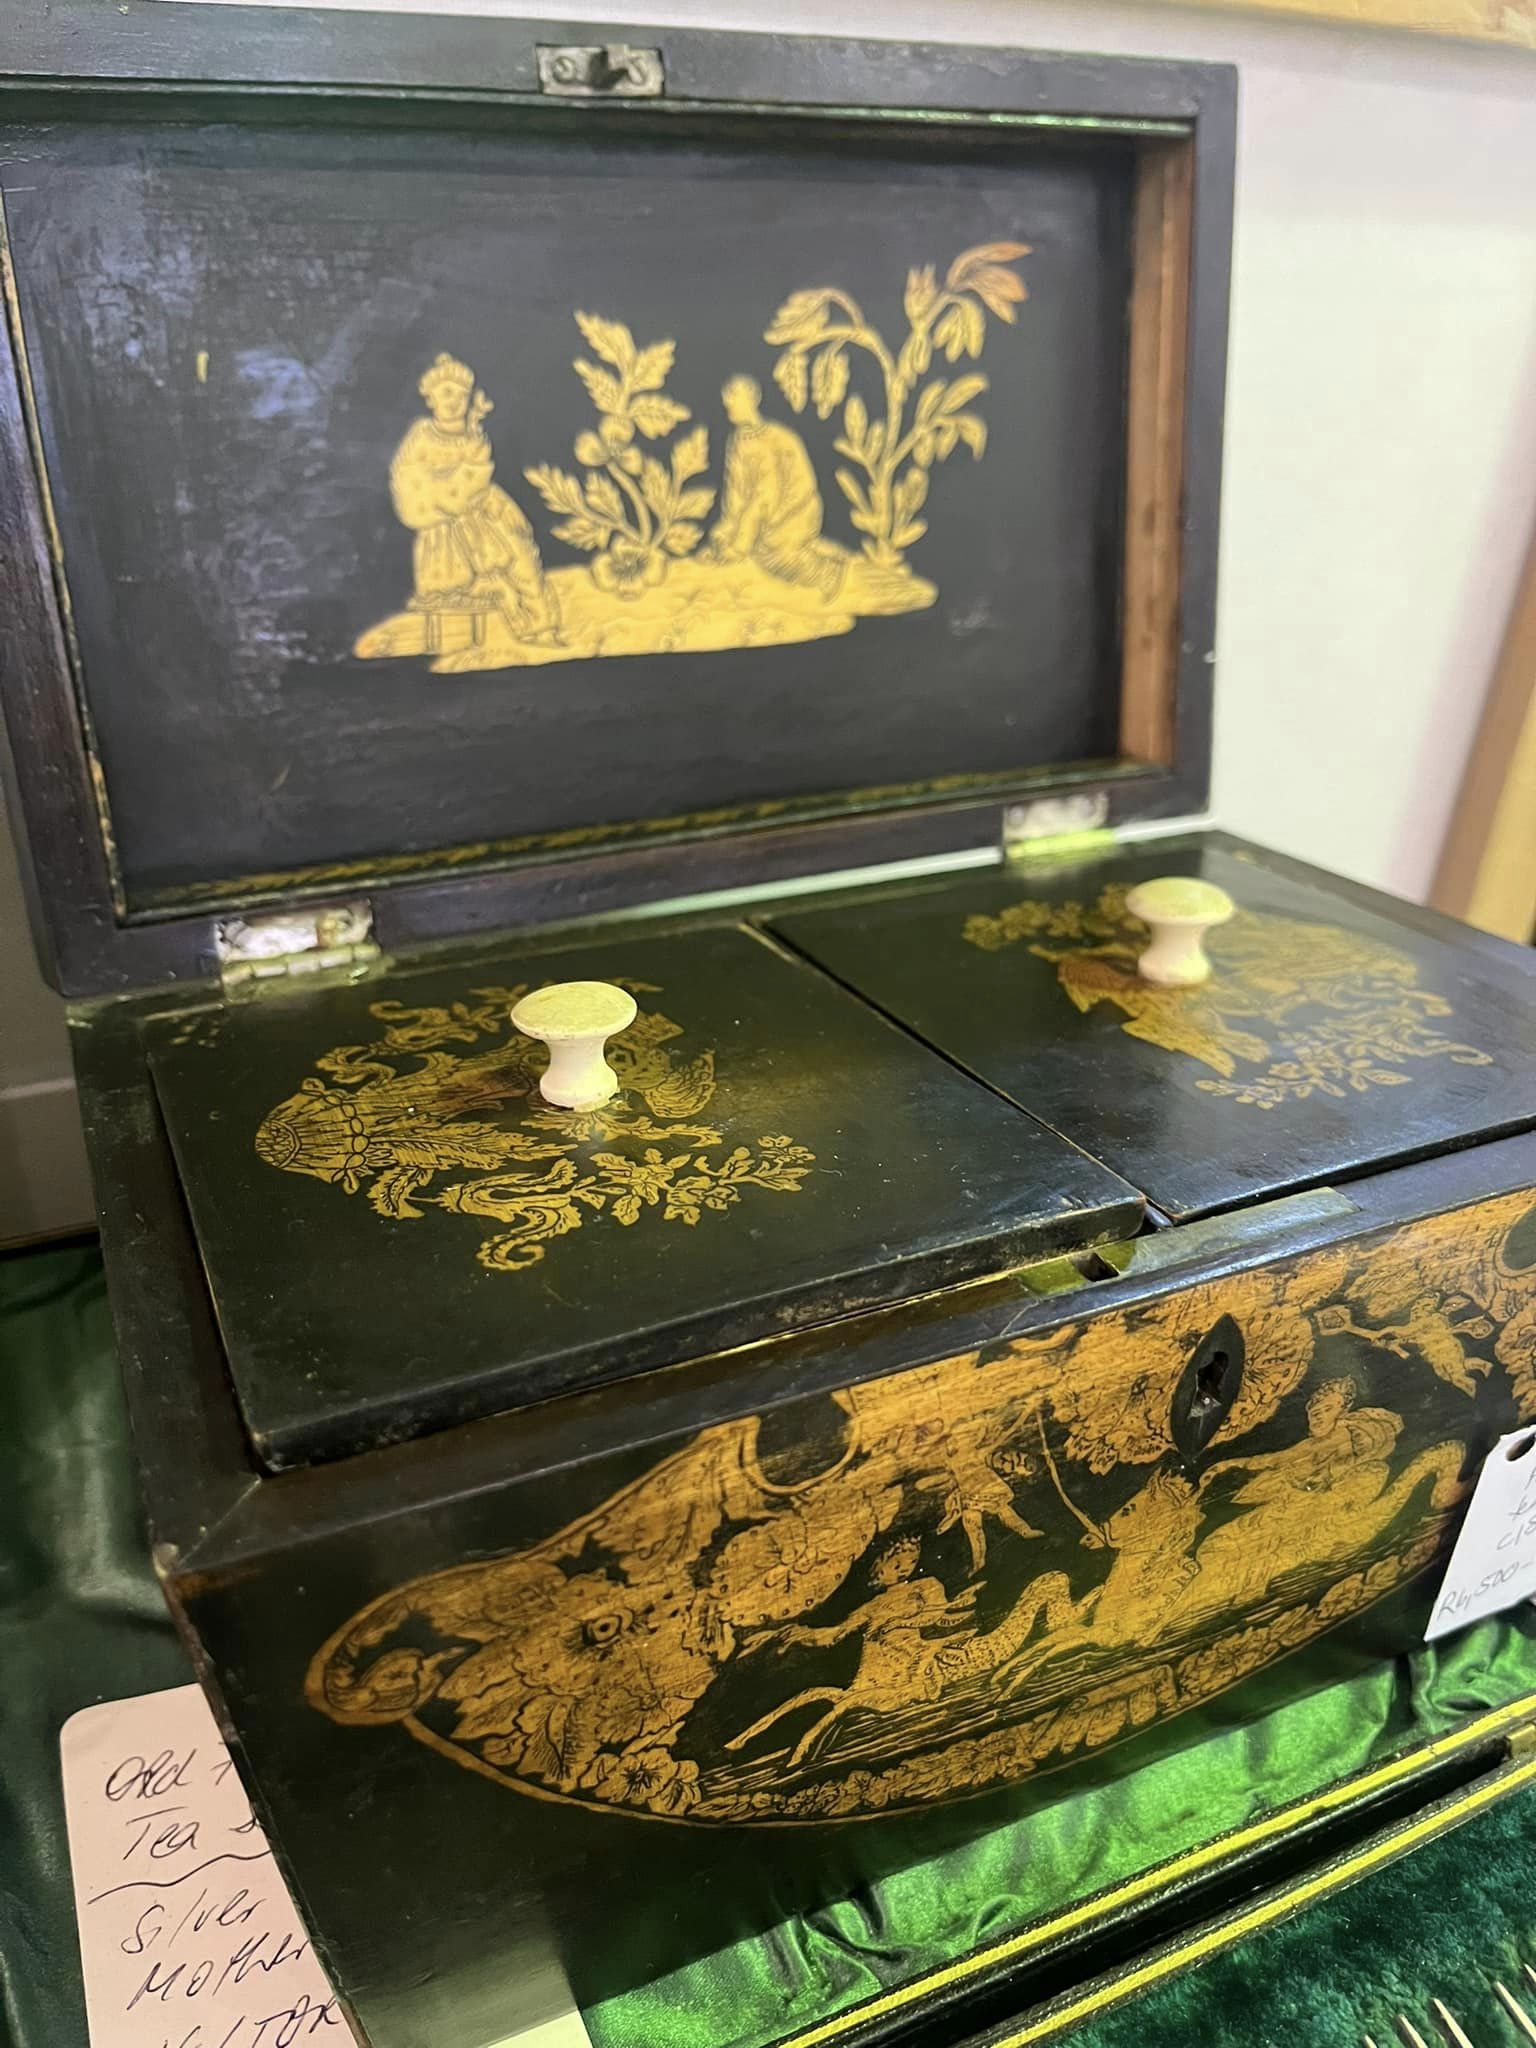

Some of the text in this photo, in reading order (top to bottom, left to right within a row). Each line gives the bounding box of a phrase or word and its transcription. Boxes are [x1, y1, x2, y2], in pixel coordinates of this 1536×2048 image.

[105, 1748, 198, 1801] Old
[122, 1806, 201, 1861] Tea
[120, 1888, 267, 1954] Silver
